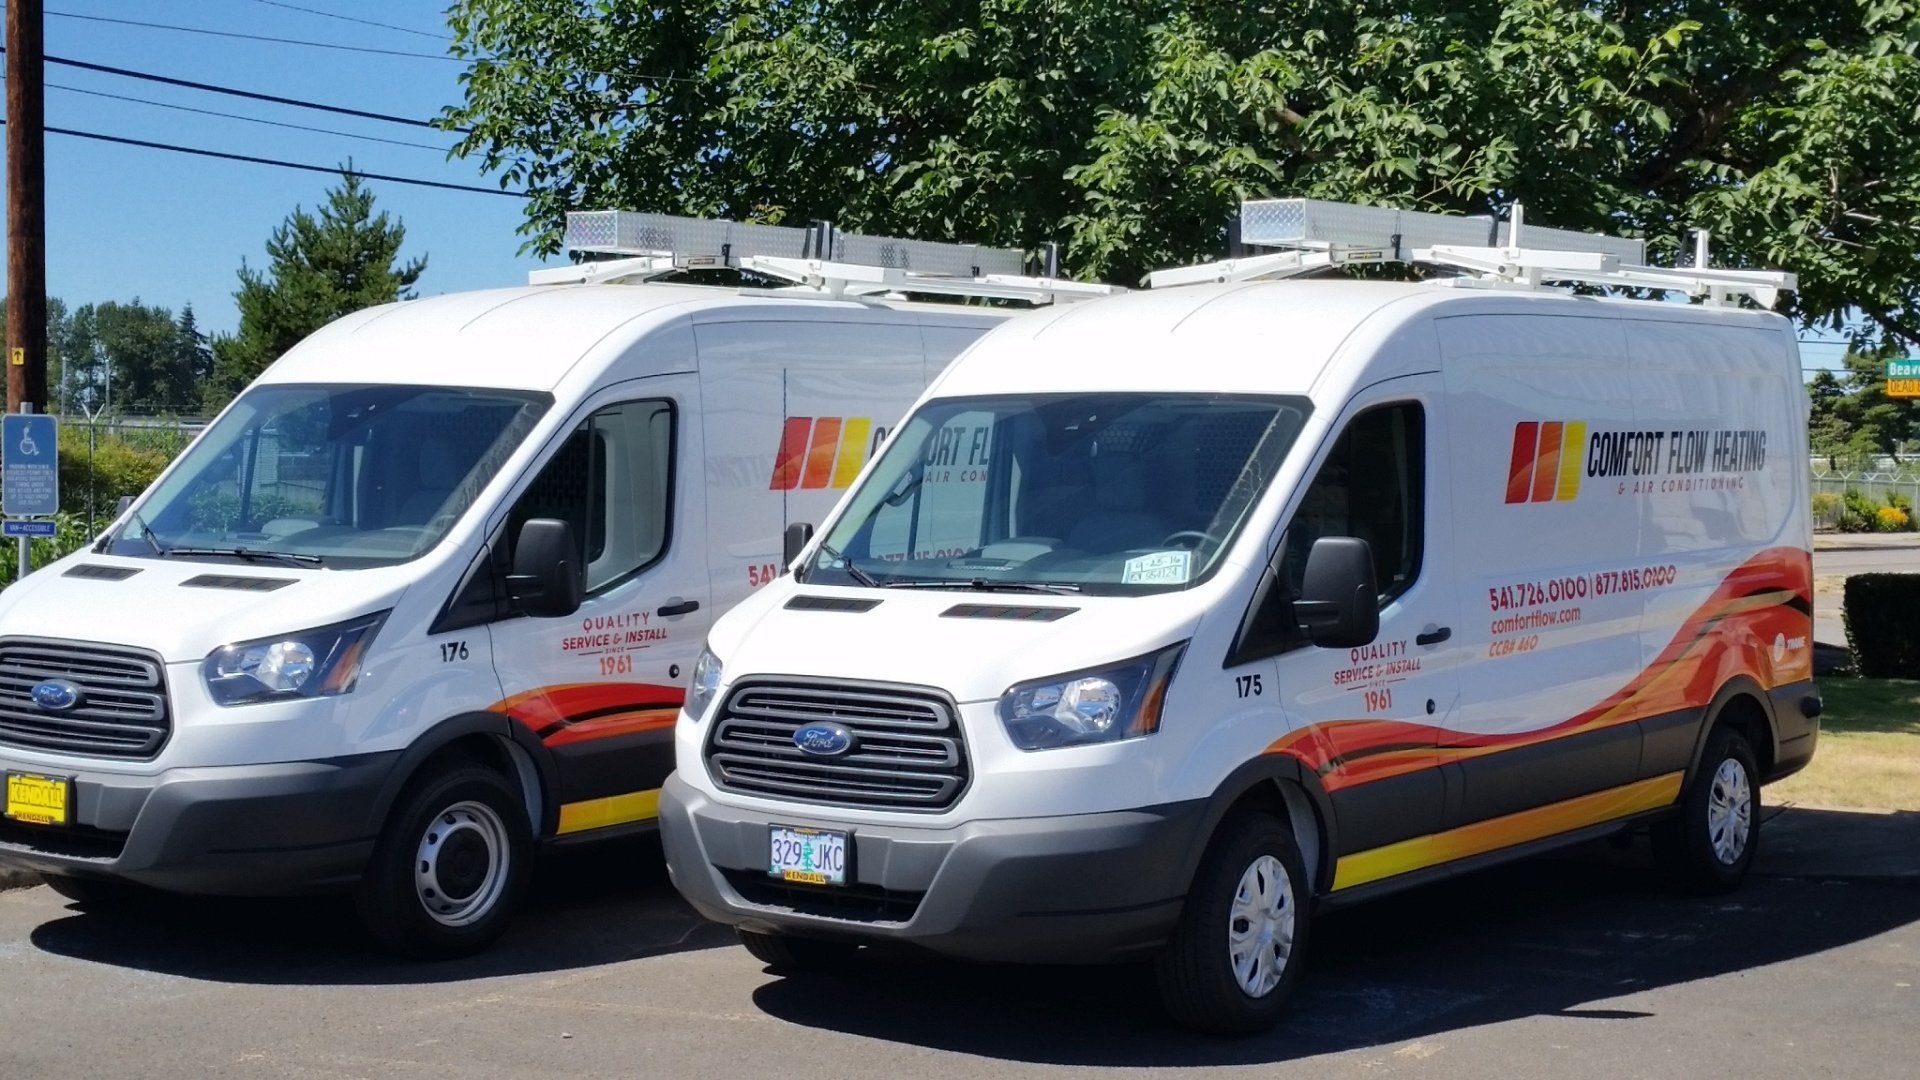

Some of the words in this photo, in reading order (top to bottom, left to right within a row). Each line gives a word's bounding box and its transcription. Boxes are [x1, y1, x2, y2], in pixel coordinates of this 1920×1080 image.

[1891, 380, 1914, 392] DEAD
[1587, 430, 1664, 477] COMFORT
[1667, 430, 1709, 474] FLOW
[1711, 430, 1767, 473] HEATING
[924, 470, 950, 483] AIR
[1632, 481, 1654, 494] AIR
[1661, 477, 1745, 493] CONDITIONING
[583, 612, 650, 634] QUALITY
[1491, 606, 1581, 635] comfortflow.com
[562, 633, 610, 651] SERVICE
[612, 632, 622, 644] &
[624, 627, 668, 643] INSTALL
[605, 646, 625, 654] SINCE
[1516, 634, 1539, 652] 460
[439, 640, 469, 663] 176
[1350, 639, 1408, 666] QUALITY
[599, 654, 633, 675] 1961
[1334, 665, 1373, 685] SERVICE
[1385, 657, 1421, 675] INSTALL
[1235, 674, 1263, 698] 175
[1364, 688, 1392, 712] 1961
[803, 729, 834, 748] Ford
[10, 782, 63, 809] KENDALL
[773, 838, 803, 866] 329
[814, 843, 843, 872] JKC
[785, 871, 825, 883] KENDALL
